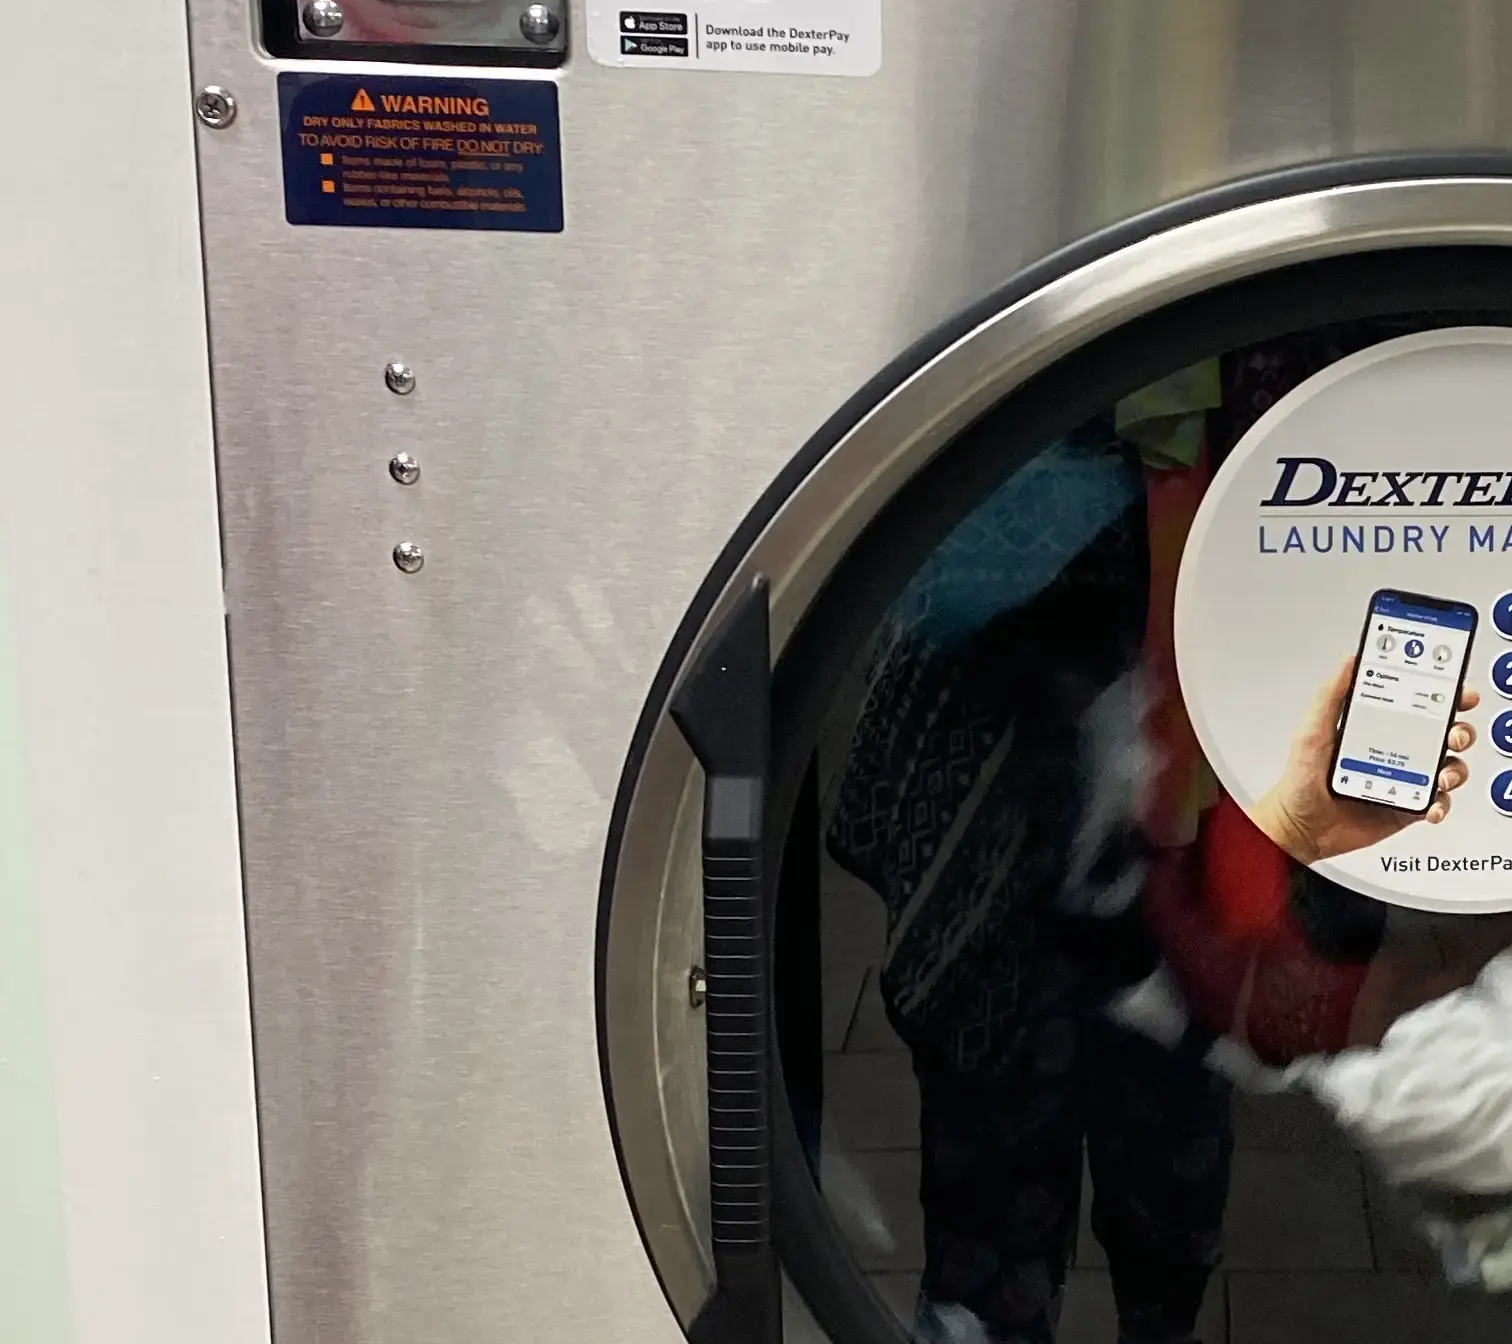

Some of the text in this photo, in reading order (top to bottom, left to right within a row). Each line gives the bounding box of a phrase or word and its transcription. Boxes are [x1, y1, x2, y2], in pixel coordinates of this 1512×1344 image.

[659, 22, 683, 31] Store
[706, 24, 850, 43] Download the DexterPay
[706, 41, 727, 52] app
[731, 40, 742, 51] to
[746, 43, 766, 51] use
[770, 42, 810, 53] mobile
[381, 95, 489, 117] WARNING
[303, 116, 537, 134] DRY ONLY FABRICS WASHED IN WATER
[298, 133, 319, 146] TO
[320, 134, 363, 148] AVOID
[365, 136, 398, 149] RISK
[400, 137, 420, 150] OF
[423, 138, 454, 152] FIRE
[457, 139, 479, 152] DO
[481, 139, 510, 153] NOT
[1259, 525, 1450, 553] LAUNDRY
[1380, 855, 1422, 873] Visit
